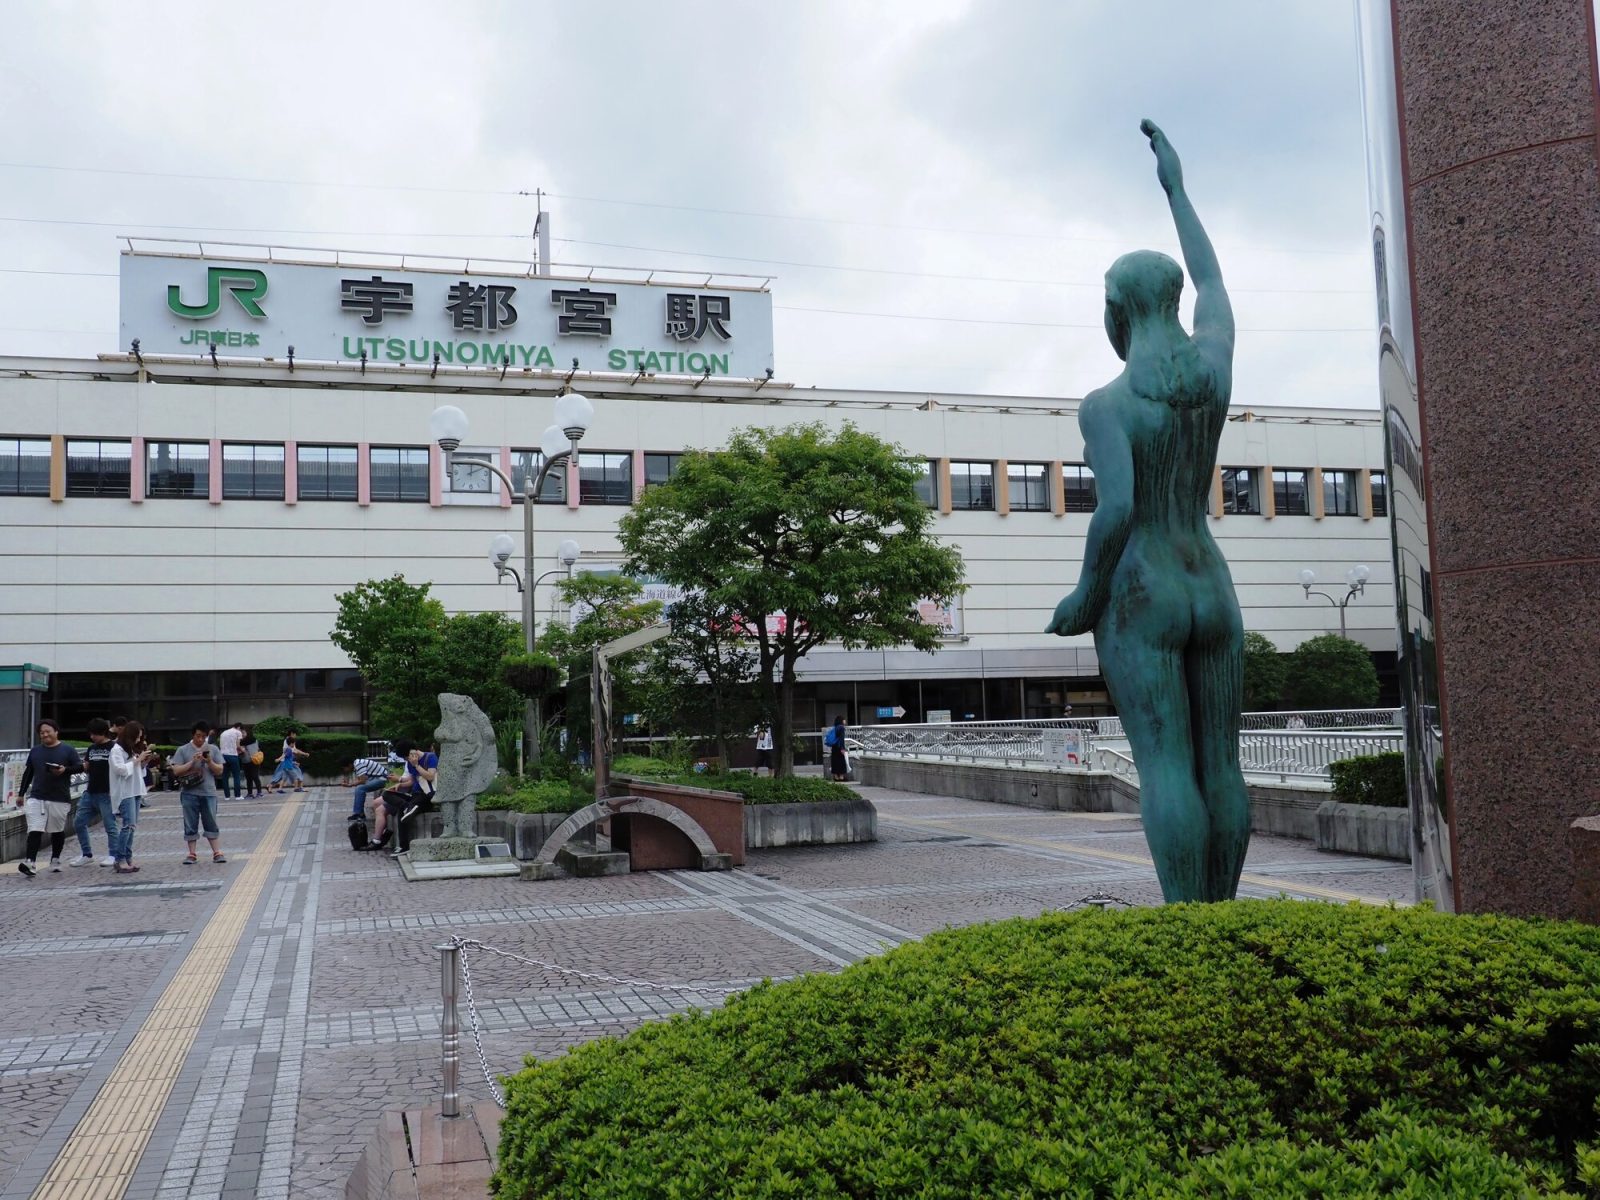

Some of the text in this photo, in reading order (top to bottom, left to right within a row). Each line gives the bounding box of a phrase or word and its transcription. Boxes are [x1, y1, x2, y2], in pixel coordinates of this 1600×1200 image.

[167, 266, 269, 319] JR
[340, 276, 732, 342] 宇都宮駅
[179, 329, 260, 347] JR東日本
[343, 336, 730, 374] UTSUNOMIYA STATION
